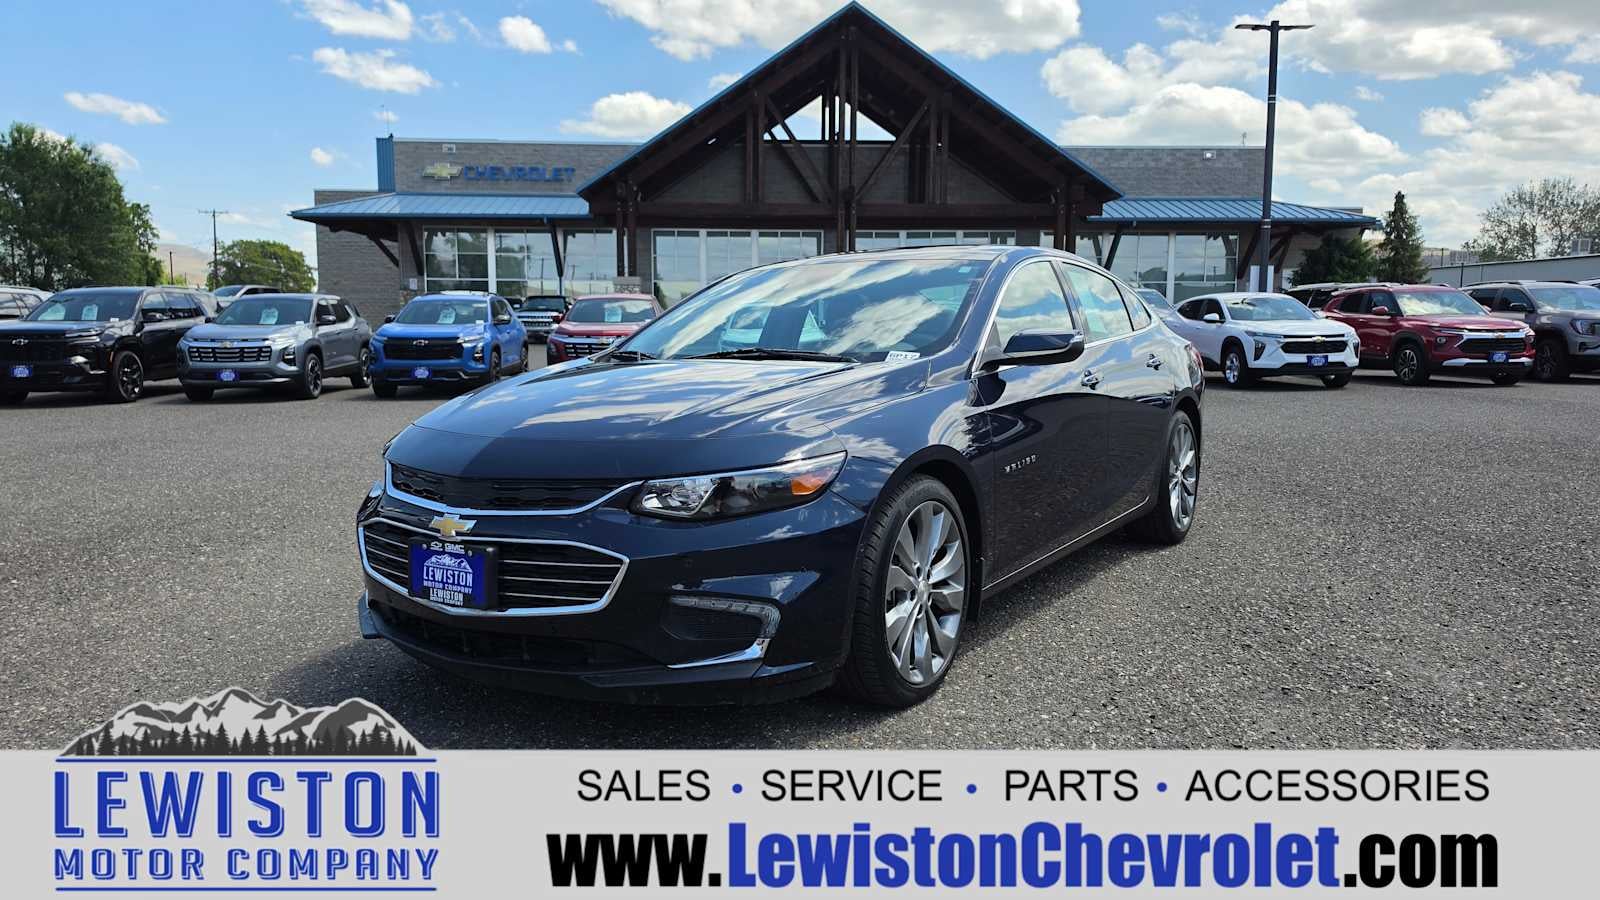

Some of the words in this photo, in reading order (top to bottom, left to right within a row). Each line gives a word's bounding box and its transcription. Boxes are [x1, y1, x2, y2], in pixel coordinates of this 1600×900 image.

[464, 166, 576, 182] CHEVROLET
[444, 543, 465, 552] GMC
[423, 566, 473, 587] LEWISTON
[423, 580, 444, 589] MOTOR
[444, 583, 473, 594] COMPANY
[430, 588, 464, 601] LEWISTON
